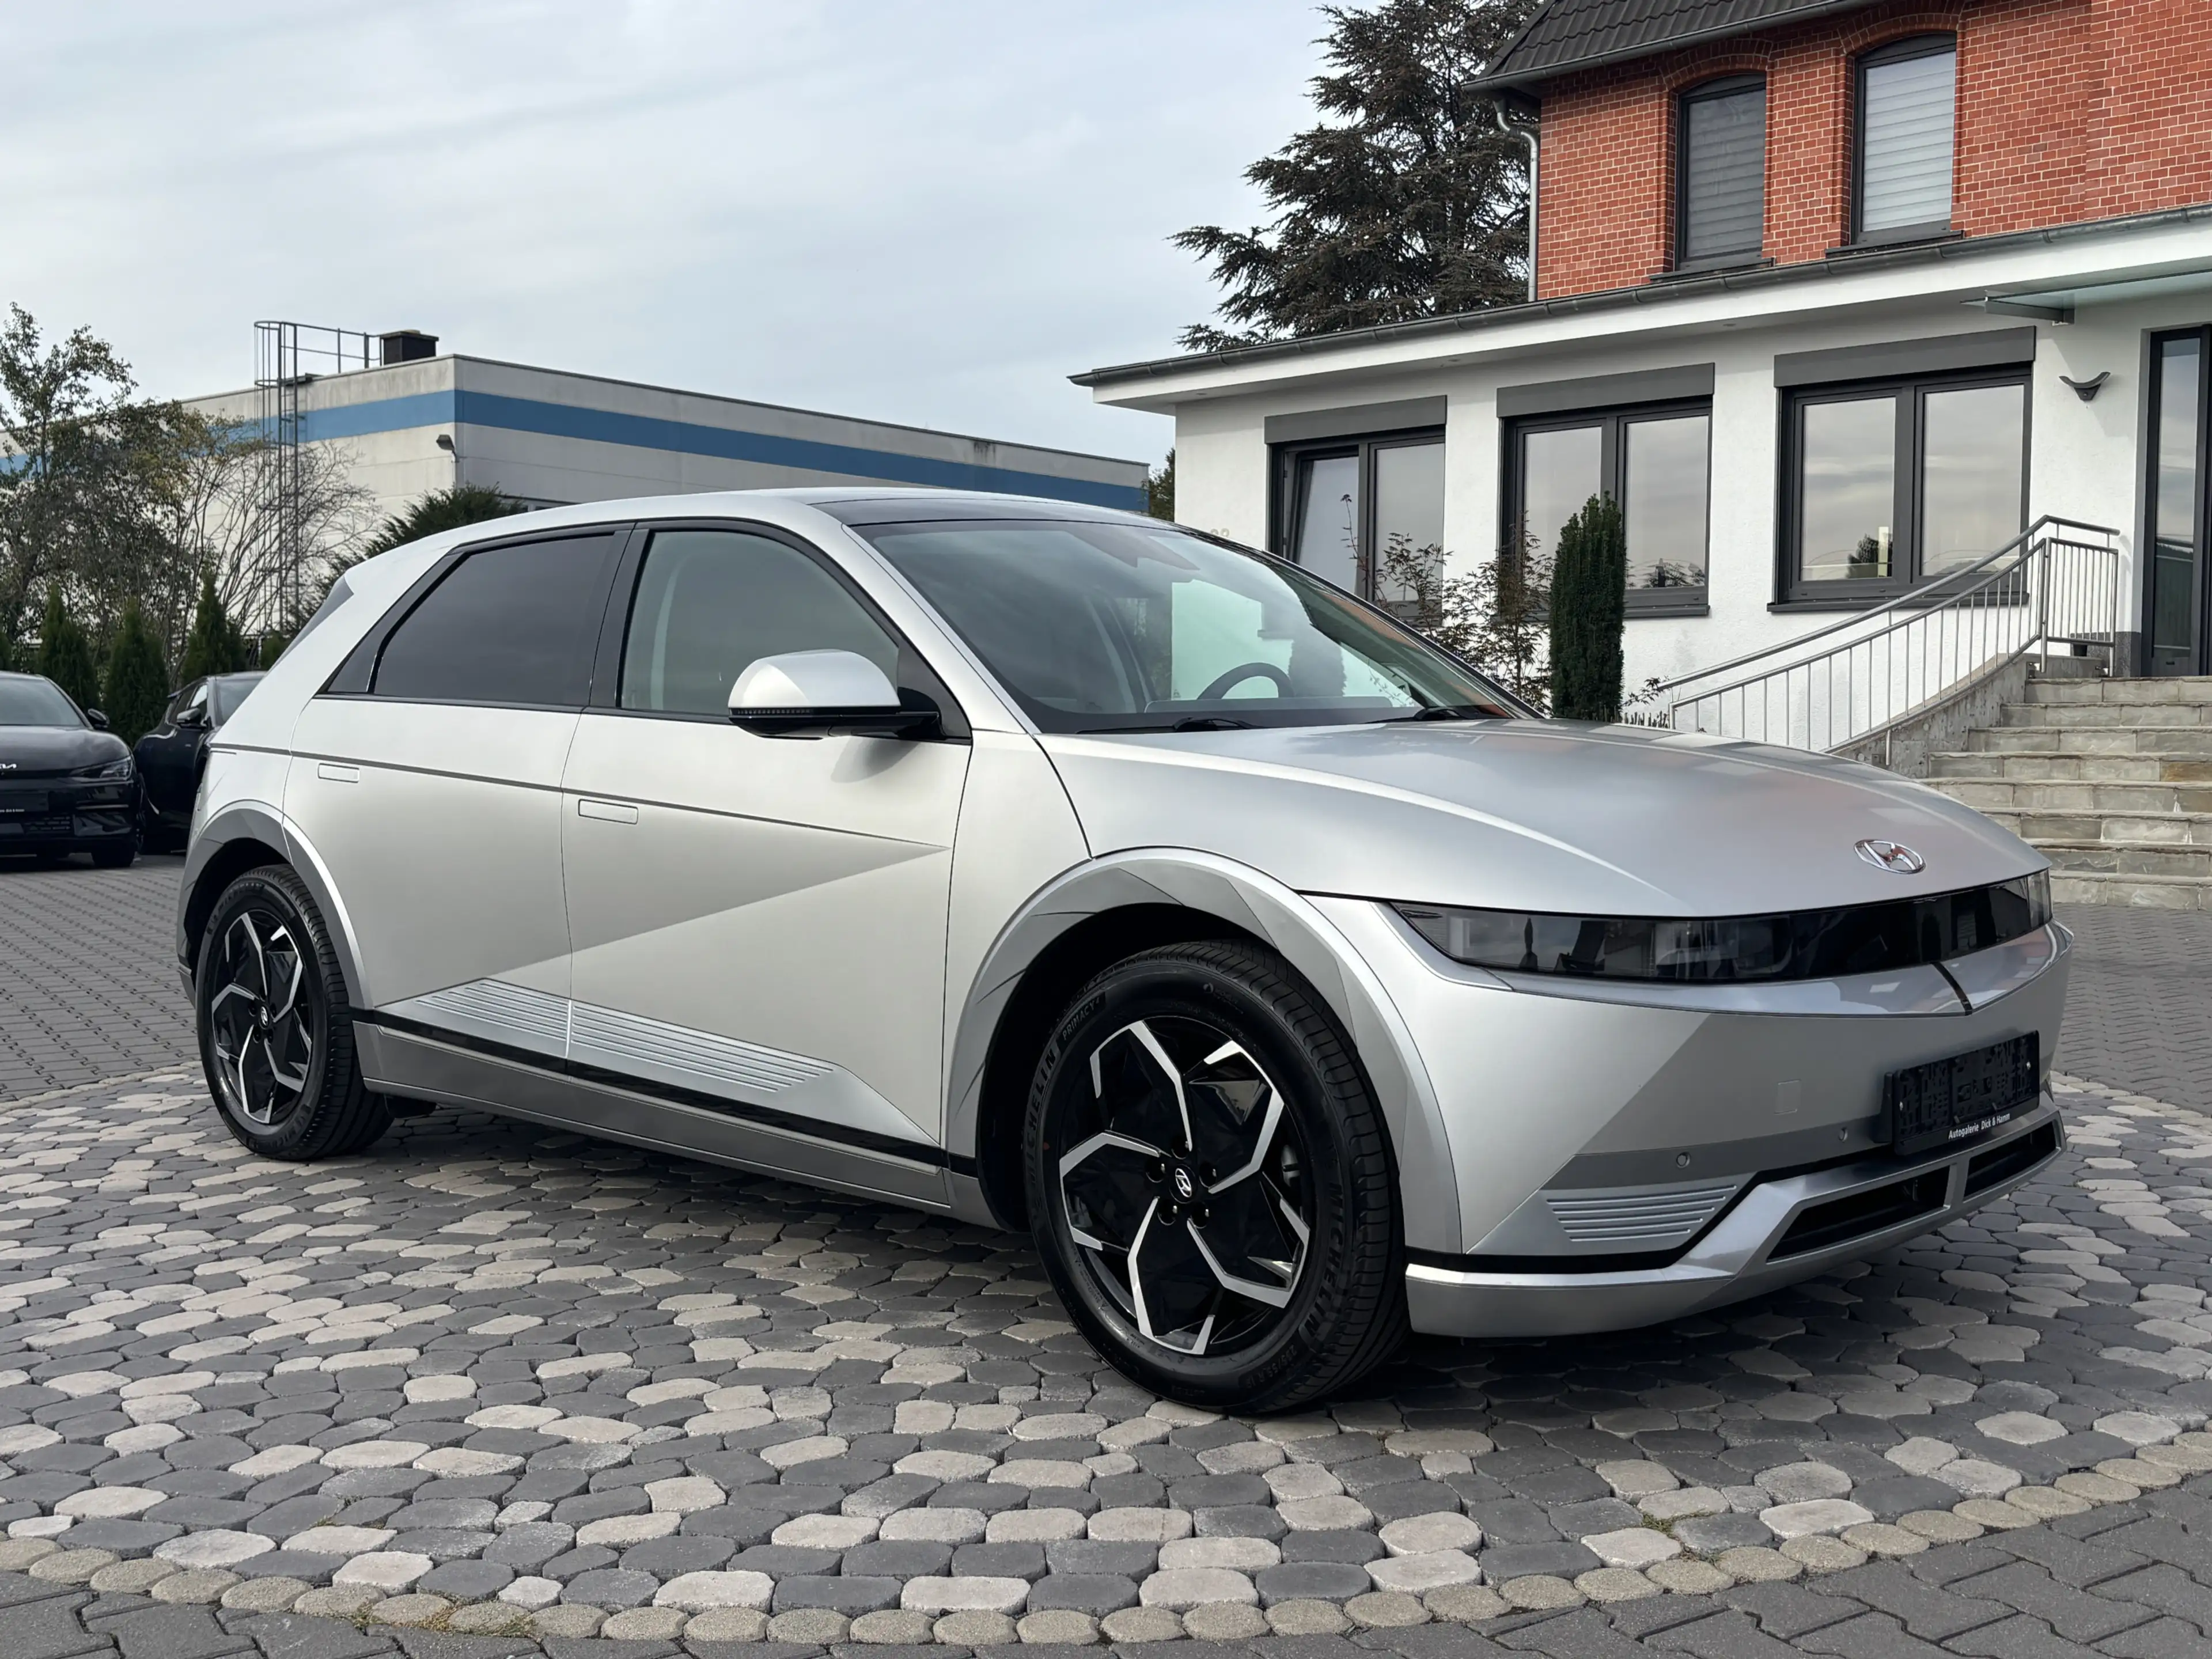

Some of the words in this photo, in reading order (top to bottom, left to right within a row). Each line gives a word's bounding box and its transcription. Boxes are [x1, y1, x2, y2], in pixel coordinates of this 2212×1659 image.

[1025, 1048, 1056, 1184] MICHELIN
[1062, 1000, 1094, 1041] PRIMACY
[1948, 1122, 1979, 1140] Autogalerie
[1981, 1118, 1991, 1130] Dick
[1304, 1182, 1344, 1338] MICHELIN
